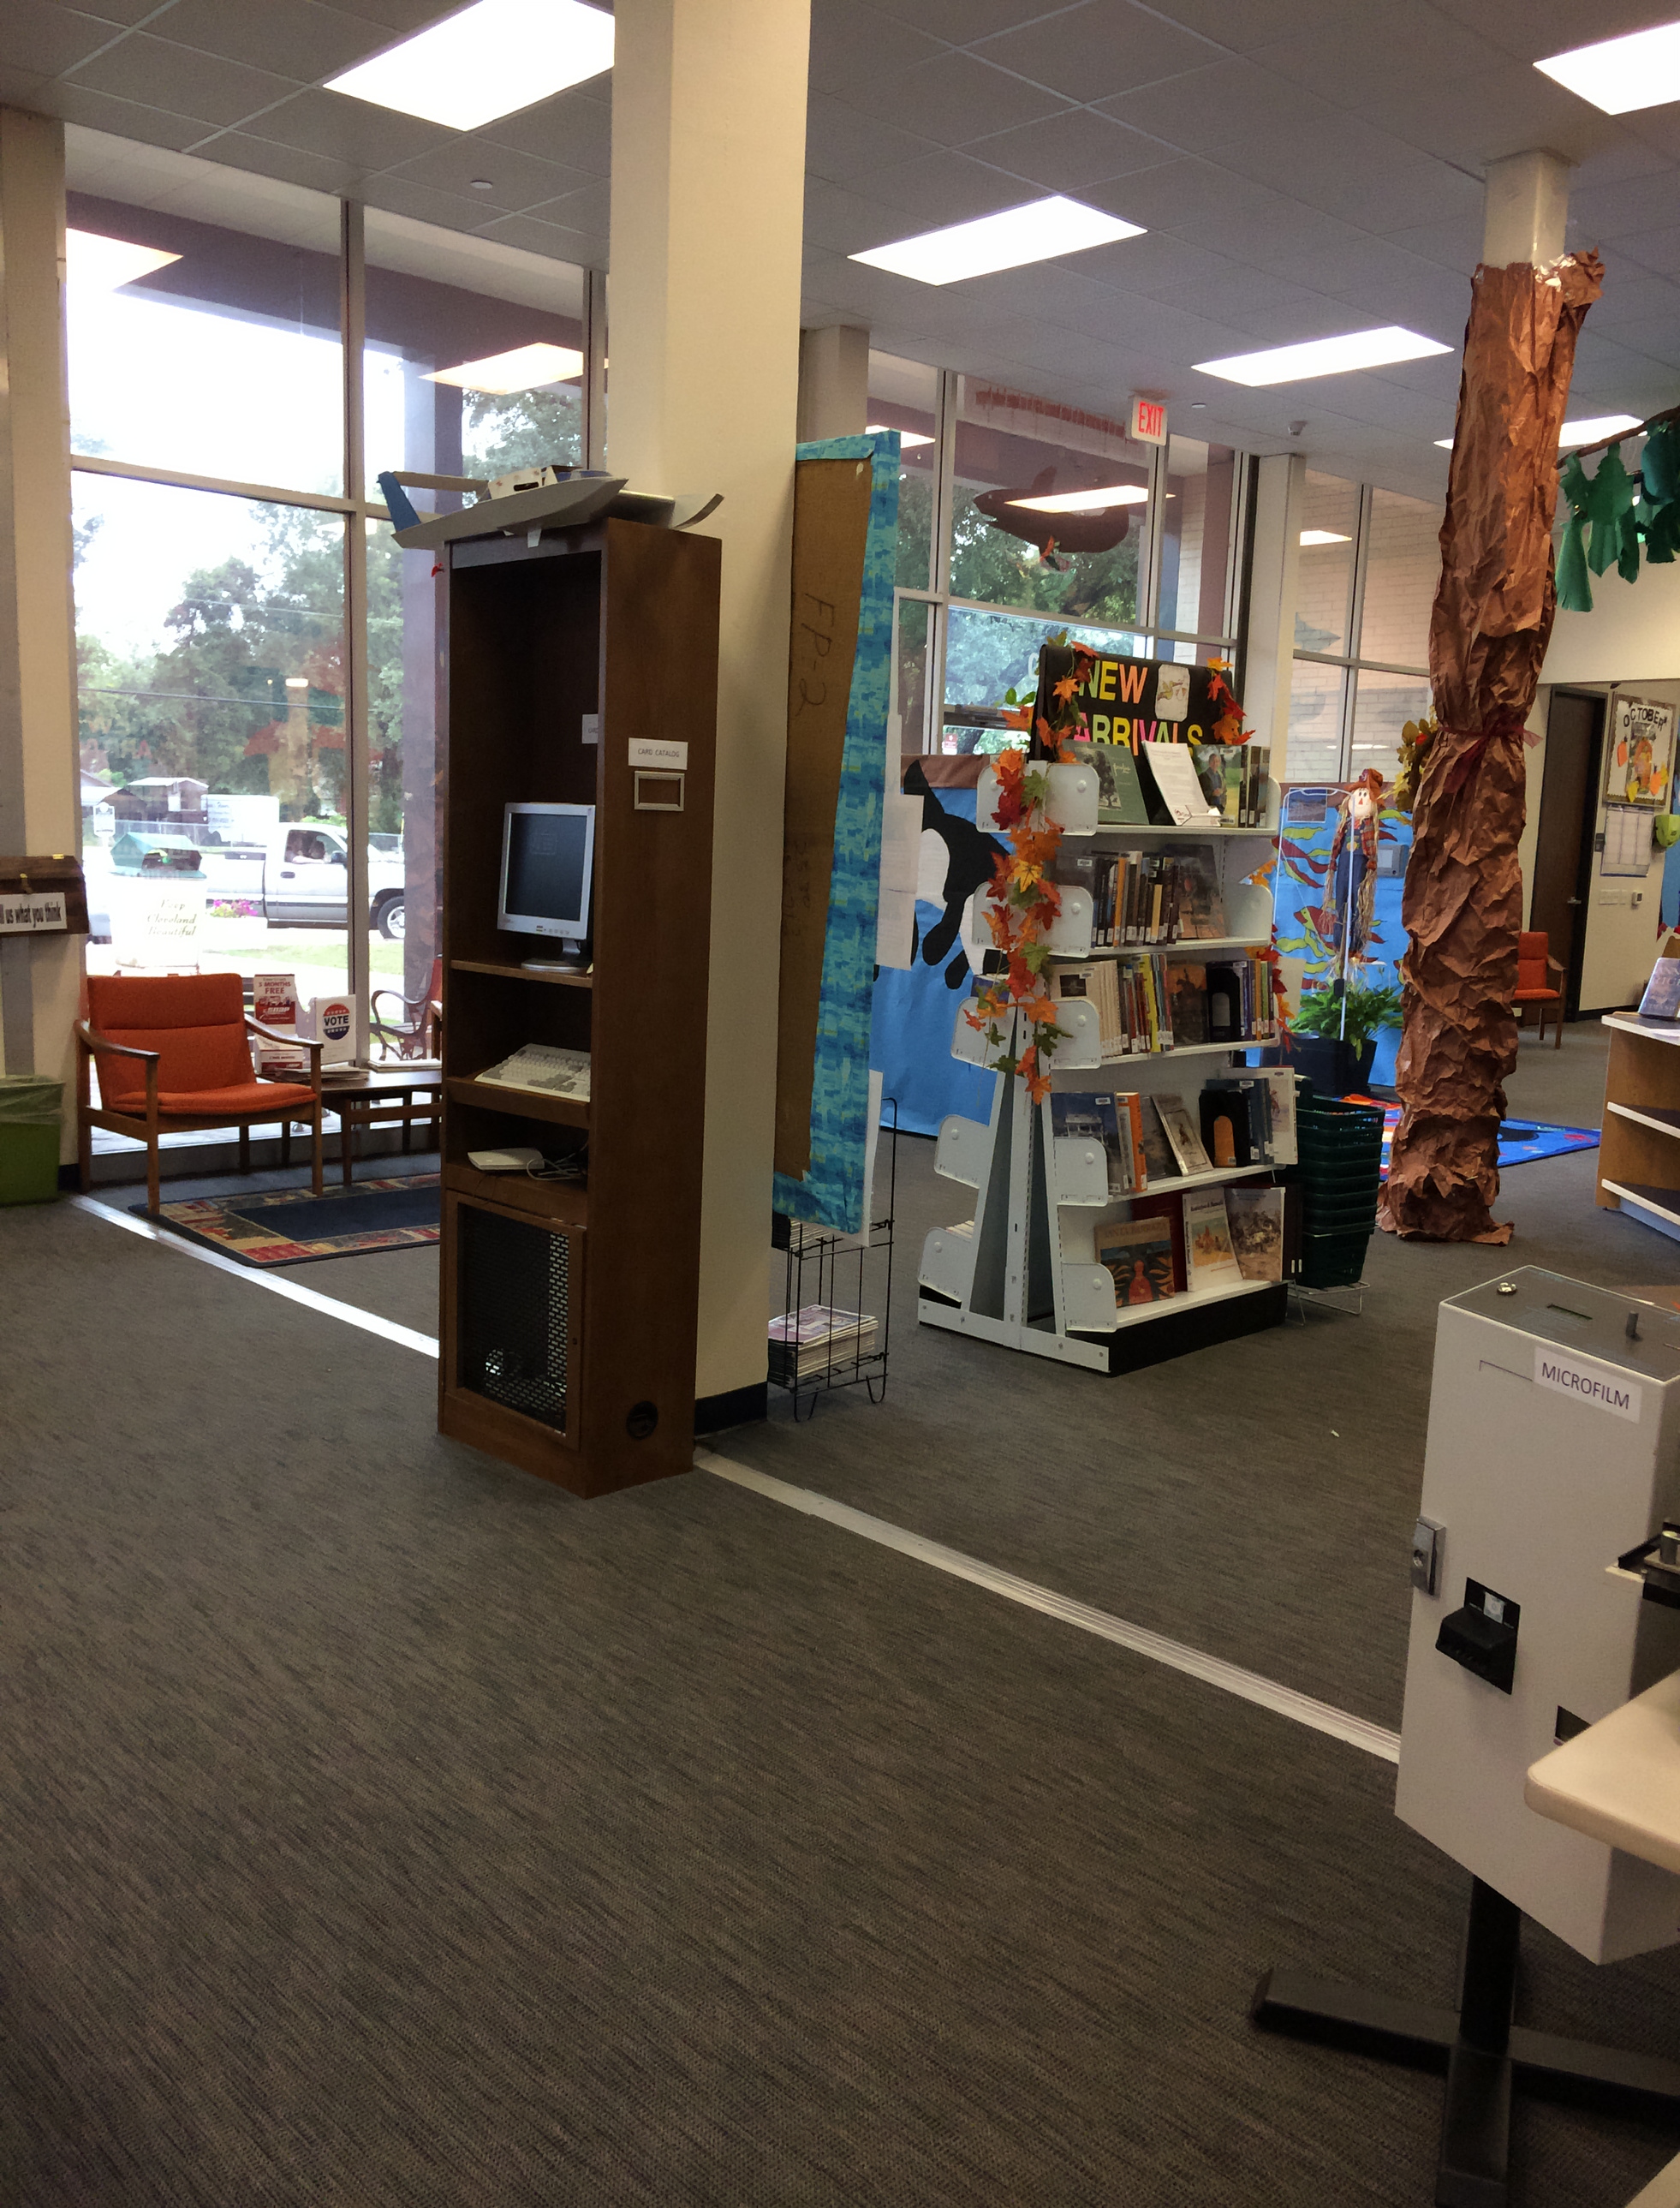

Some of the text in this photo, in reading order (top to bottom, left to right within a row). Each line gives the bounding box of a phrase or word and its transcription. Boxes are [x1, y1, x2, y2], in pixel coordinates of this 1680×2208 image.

[1138, 401, 1165, 438] EXIT
[1078, 659, 1148, 705] NEW
[1623, 707, 1665, 731] OCTOBER
[654, 749, 680, 758] CATALOG
[324, 1014, 349, 1026] VOTE
[1541, 1361, 1630, 1410] MICROFILM
